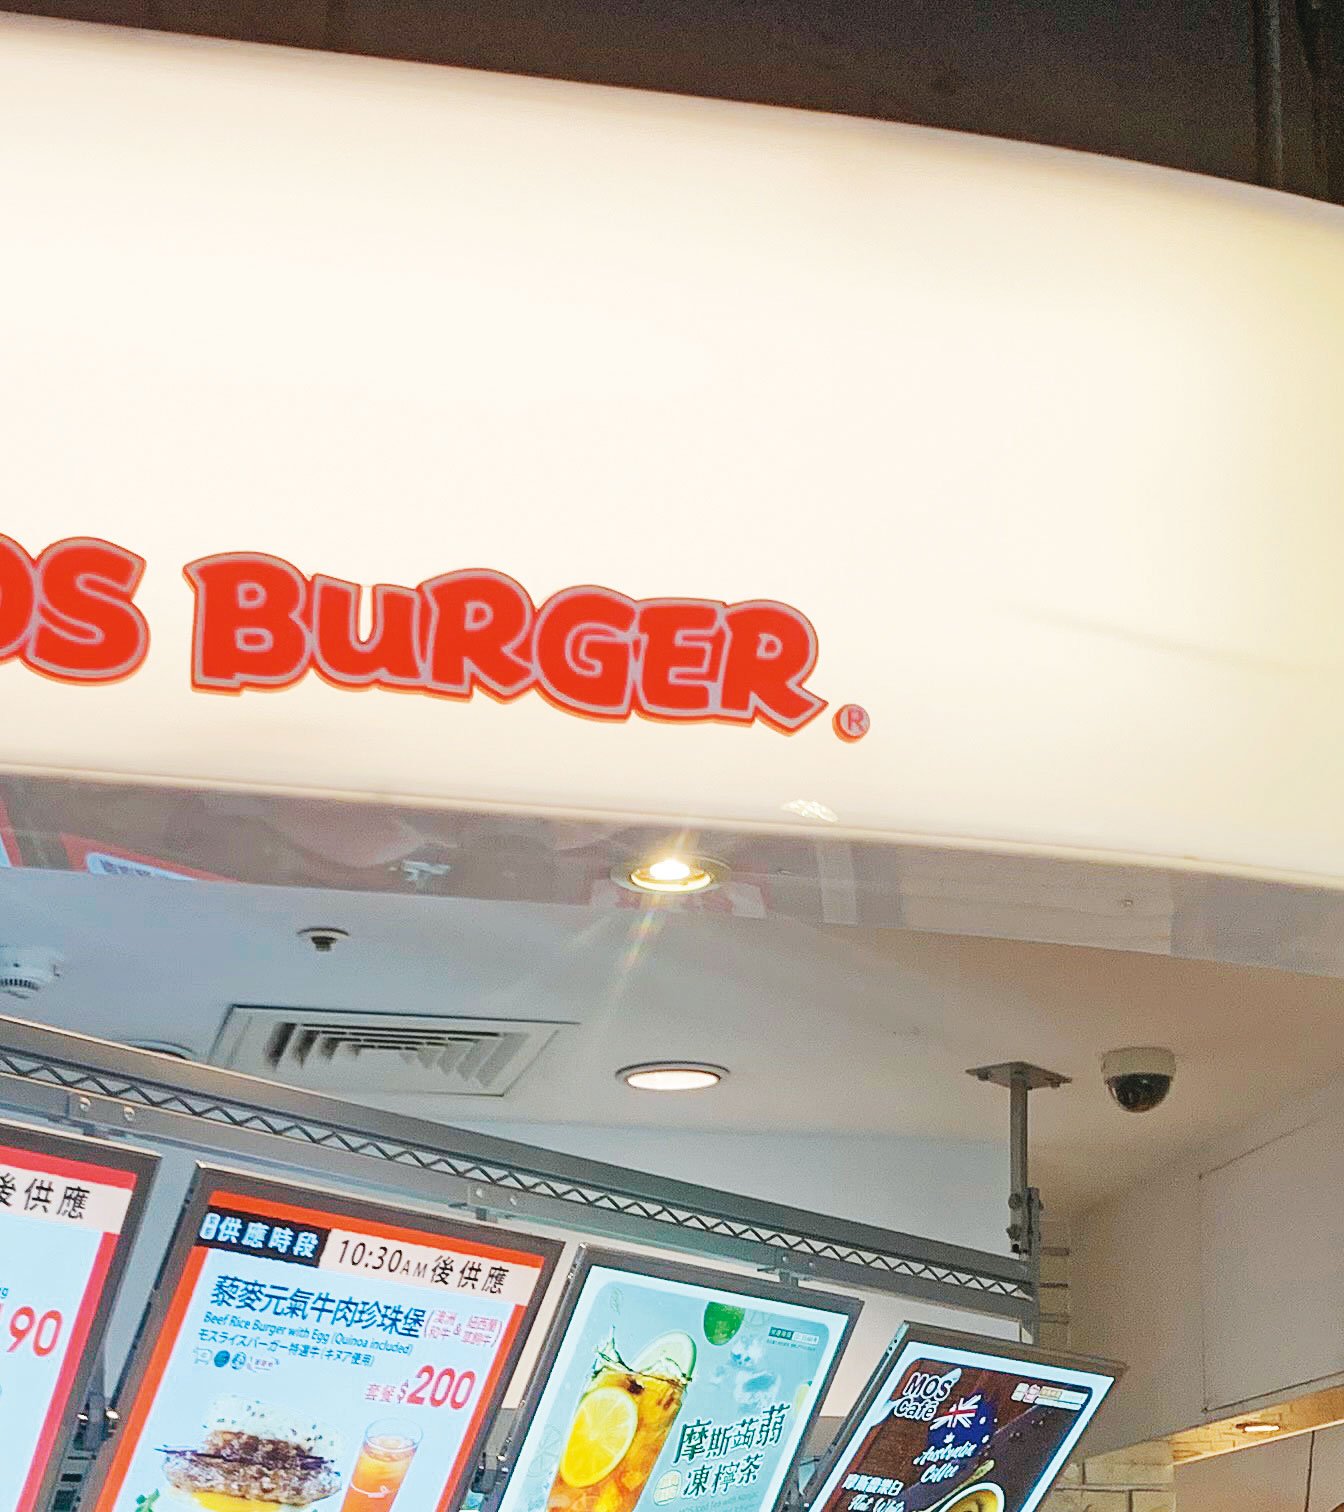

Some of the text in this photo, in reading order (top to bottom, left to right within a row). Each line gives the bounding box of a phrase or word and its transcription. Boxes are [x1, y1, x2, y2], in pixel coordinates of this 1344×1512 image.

[183, 550, 828, 731] BURGER
[210, 1274, 427, 1340] 藜麥元氣牛肉珍珠堡
[203, 1311, 227, 1327] Beef
[229, 1315, 252, 1330] Rice
[252, 1319, 288, 1337] Burger
[288, 1326, 310, 1339] with
[311, 1329, 331, 1345] Egg
[903, 1371, 954, 1402] MOS
[894, 1397, 938, 1422] Café
[672, 1401, 793, 1466] 摩斯蒟蒻
[682, 1451, 763, 1498] 凍檸茶
[920, 1464, 960, 1484] Coffee
